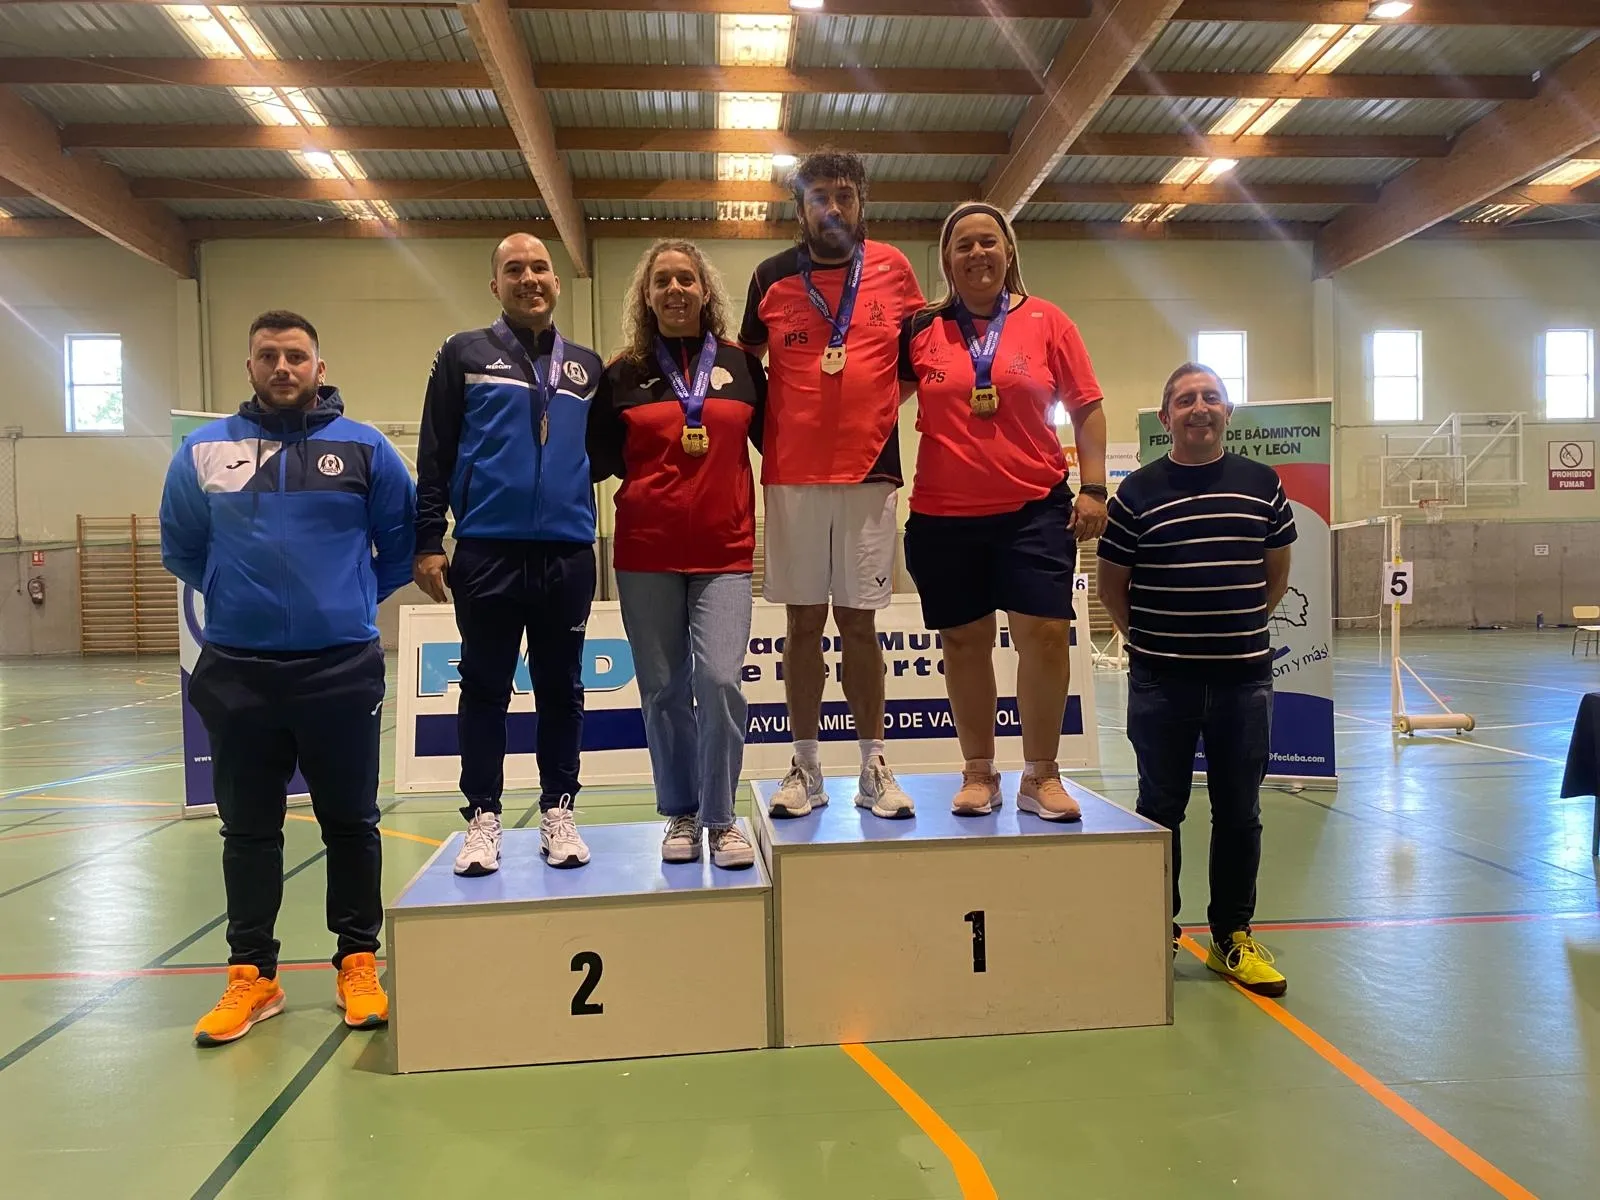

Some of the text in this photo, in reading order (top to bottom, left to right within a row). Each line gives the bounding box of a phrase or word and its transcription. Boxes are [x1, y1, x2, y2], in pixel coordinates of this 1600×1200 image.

[1226, 429, 1241, 441] DE
[1245, 426, 1320, 440] BÁDMINTON
[1253, 444, 1261, 456] Y
[1266, 441, 1301, 456] LEÓN
[1560, 480, 1585, 488] FUMAR
[1075, 578, 1086, 590] 6
[1390, 571, 1408, 596] 5
[1291, 658, 1300, 671] y
[900, 712, 923, 728] DE
[963, 910, 988, 973] 1
[571, 951, 604, 1015] 2
